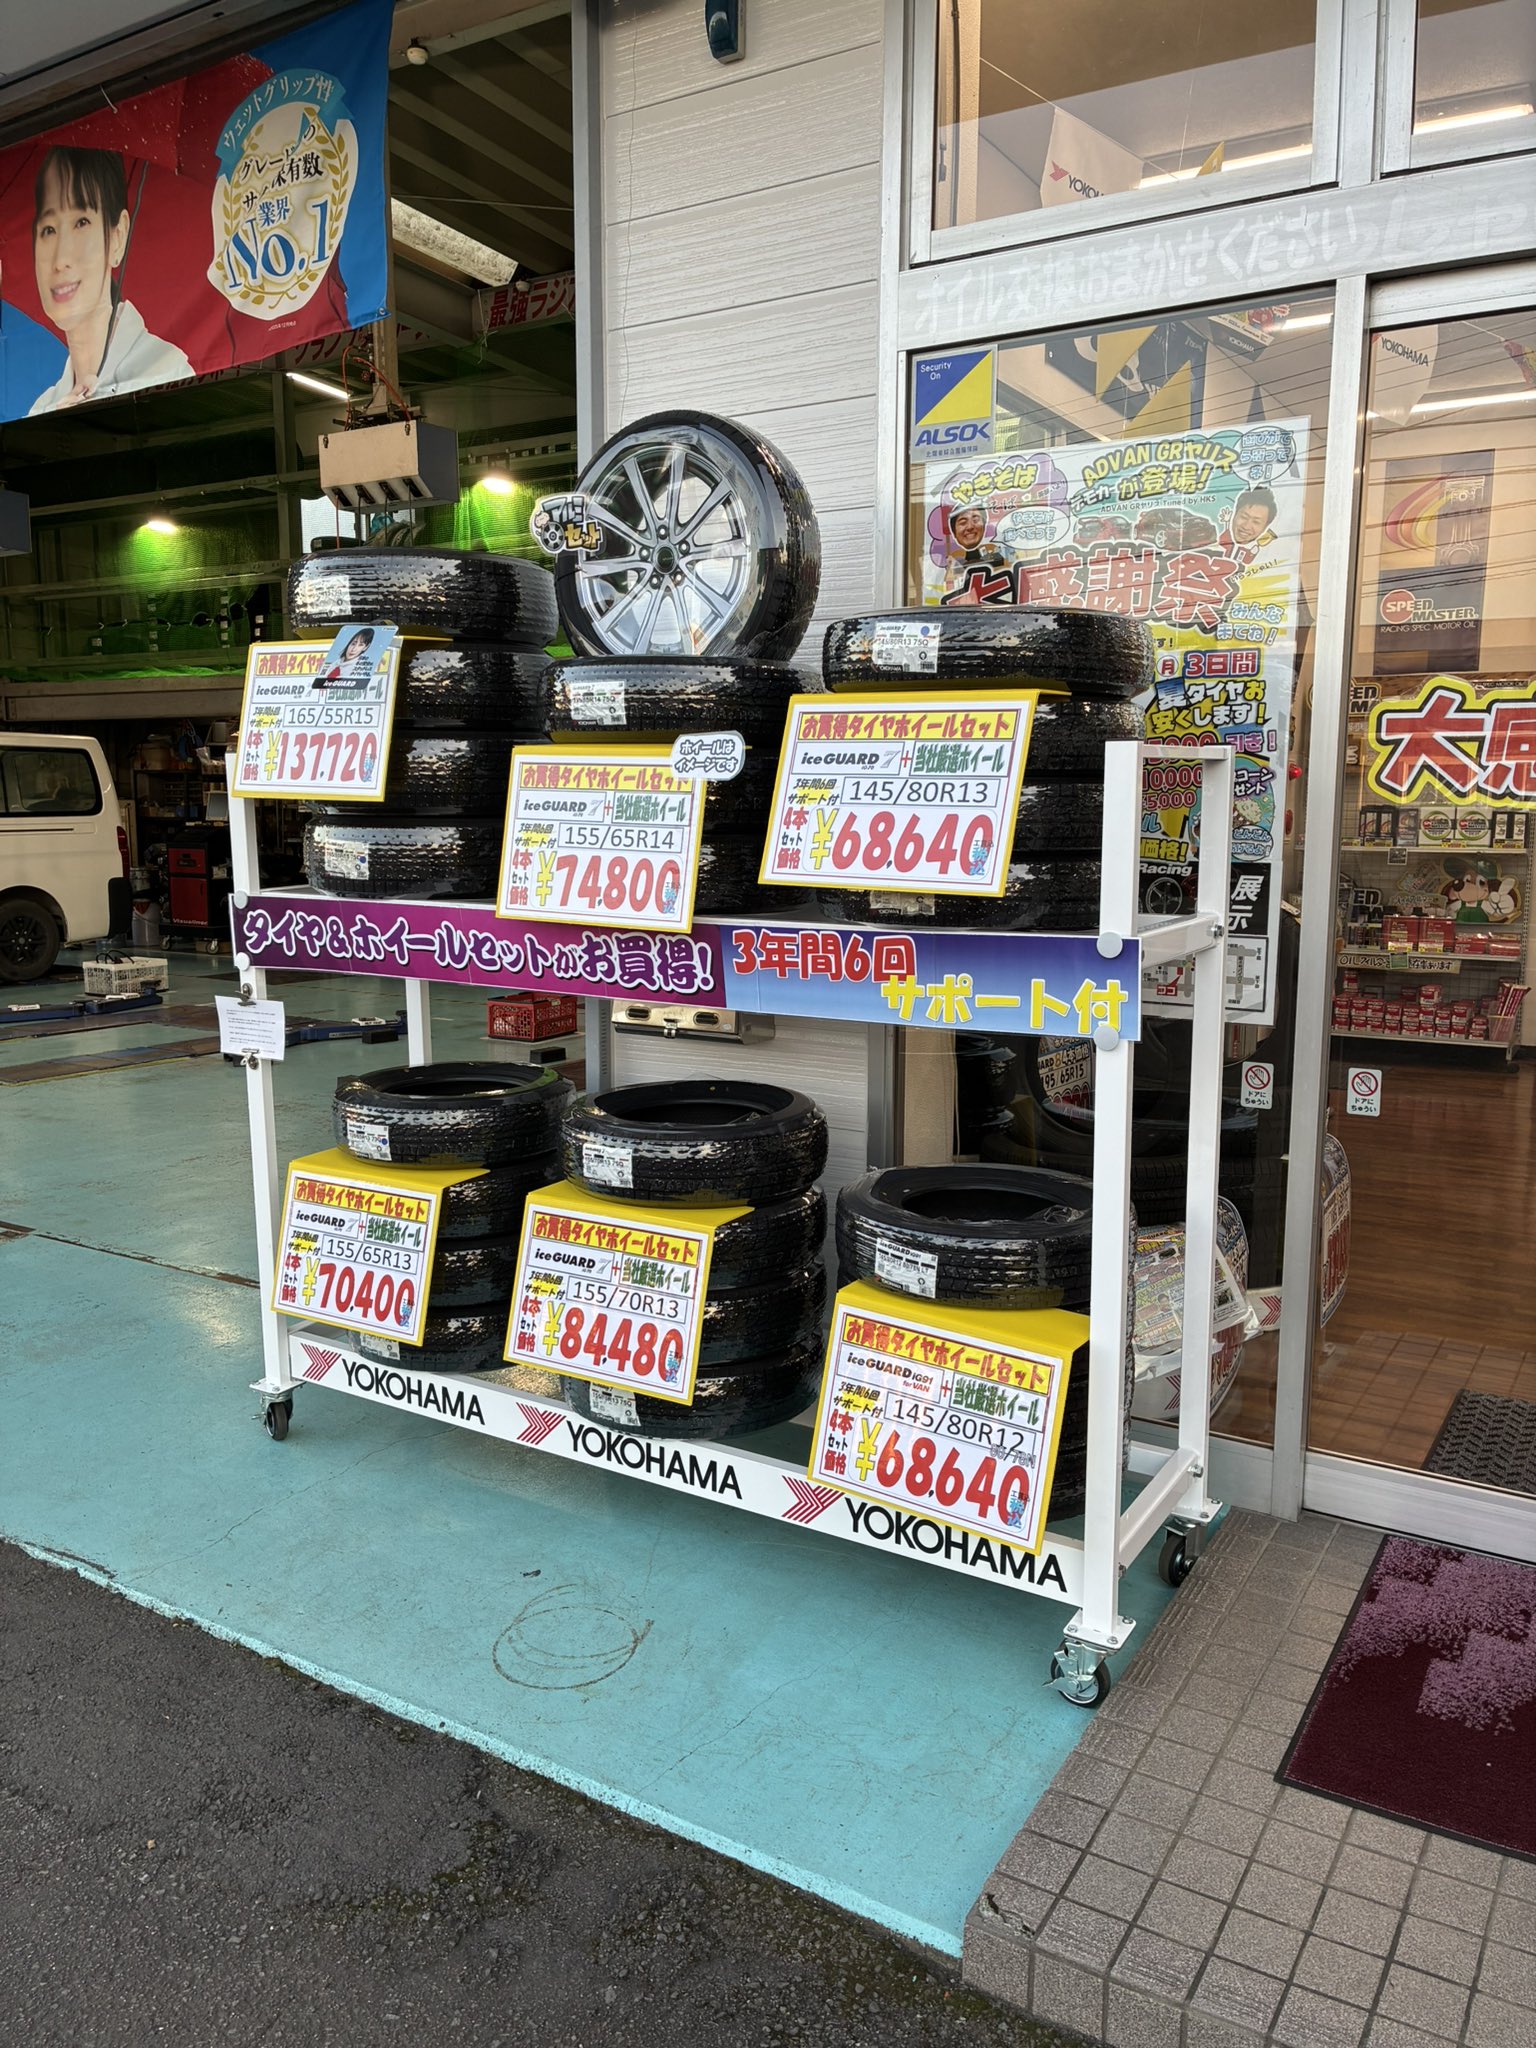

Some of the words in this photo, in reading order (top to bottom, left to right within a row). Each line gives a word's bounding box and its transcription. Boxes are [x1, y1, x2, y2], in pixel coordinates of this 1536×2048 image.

[222, 73, 335, 151] ウェットグリップ性
[259, 196, 290, 228] 業界
[224, 199, 329, 289] No.1
[1380, 335, 1429, 367] YOKOHAMA
[920, 361, 952, 373] Security
[930, 371, 941, 381] On
[915, 422, 990, 447] ALSOK
[1082, 443, 1151, 488] ADVAN
[1155, 439, 1238, 474] GRヤリス
[951, 463, 1039, 505] やきそば
[1101, 503, 1128, 513] ADVAN
[1188, 496, 1199, 505] by
[1200, 495, 1216, 503] HKS
[564, 521, 602, 549] セット
[944, 544, 1237, 629] 大感謝祭
[1231, 602, 1283, 625] みんな
[1385, 597, 1434, 614] SPEED
[1411, 604, 1476, 622] MASTER
[1217, 622, 1279, 646] 来てね!
[1380, 621, 1411, 634] RACING
[1411, 622, 1431, 632] SPEC
[1433, 620, 1462, 630] MOTOR
[1464, 619, 1477, 629] OIL
[1160, 658, 1176, 676] 月
[1186, 650, 1260, 676] 3日間
[256, 685, 305, 696] iceGUARD
[250, 718, 282, 728] サポート付
[288, 706, 374, 727] 165/55R15
[802, 713, 1010, 740] お買得タイヤホイールセット
[1152, 703, 1267, 734] 安くします!
[247, 730, 263, 749] 4本
[680, 739, 736, 755] ホイールは
[1226, 729, 1278, 752] 引き!
[246, 751, 260, 762] セット
[674, 756, 739, 773] イメージです
[801, 752, 880, 765] iceGUARD
[882, 751, 901, 769] 7
[913, 743, 1005, 774] 当社厳選ホイール
[243, 764, 259, 780] 価格
[788, 793, 840, 806] サポート付
[793, 778, 838, 790] 3年間6回
[850, 779, 989, 805] 145/80R13
[523, 800, 587, 812] iceGUARD
[614, 795, 687, 822] 当社厳選ホイール
[514, 836, 557, 849] サポート付
[518, 822, 554, 835] 3年間6回
[565, 826, 674, 850] 155/65R14
[781, 832, 803, 847] セット
[783, 807, 809, 830] 4本
[810, 807, 994, 876] ¥68,640
[1234, 828, 1272, 843] どんどん
[777, 847, 801, 870] 価格
[1139, 863, 1193, 876] Racing
[511, 872, 530, 885] セット
[512, 849, 533, 870] 4本
[536, 850, 681, 914] ¥74,800
[509, 886, 529, 906] 価格
[1228, 875, 1265, 931] 展示
[243, 908, 715, 993] タイヤ&ホイールセットがお買得!
[732, 928, 919, 984] 3年間6回
[1158, 986, 1177, 995] ココ
[881, 973, 1129, 1034] サポート付
[1244, 1098, 1270, 1107] ちゅうい
[1248, 1091, 1266, 1099] ドアに
[1354, 1097, 1374, 1105] ドアに
[1351, 1105, 1377, 1113] ちゅうい
[296, 1181, 425, 1220] お買得タイヤホイールセット
[296, 1210, 346, 1228] iceGUARD
[288, 1241, 321, 1256] サポート付
[535, 1217, 695, 1262] お買得タイヤホイールセット
[327, 1238, 412, 1271] 155/65R13
[535, 1248, 596, 1269] iceGUARD
[596, 1258, 612, 1274] 7
[283, 1273, 298, 1285] セット
[284, 1252, 303, 1272] 4本
[302, 1256, 416, 1327] ¥70,400
[281, 1288, 297, 1303] 価格
[524, 1283, 566, 1300] サポート付
[528, 1270, 564, 1286] 3年間6回
[573, 1281, 679, 1319] 155/70R13
[519, 1318, 537, 1332] セット
[516, 1333, 536, 1352] 価格
[521, 1295, 542, 1318] 4本
[542, 1301, 684, 1382] ¥84,480
[846, 1318, 1045, 1391] お買得タイヤホイールセット
[342, 1358, 486, 1426] YOKOHAMA
[847, 1352, 913, 1379] iceGUARD
[912, 1371, 934, 1385] iG91
[952, 1375, 1039, 1427] 当社厳選ホイール
[903, 1380, 913, 1388] for
[913, 1382, 931, 1393] VAN
[833, 1395, 884, 1419] サポート付
[838, 1381, 881, 1402] 3年間6回
[893, 1399, 1025, 1456] 145/80R12
[827, 1434, 848, 1449] セット
[566, 1420, 743, 1500] YOKOHAMA
[823, 1450, 847, 1476] 価格
[828, 1408, 854, 1435] 4本
[854, 1418, 1030, 1528] ¥68,640
[844, 1497, 1068, 1593] YOKOHAMA
